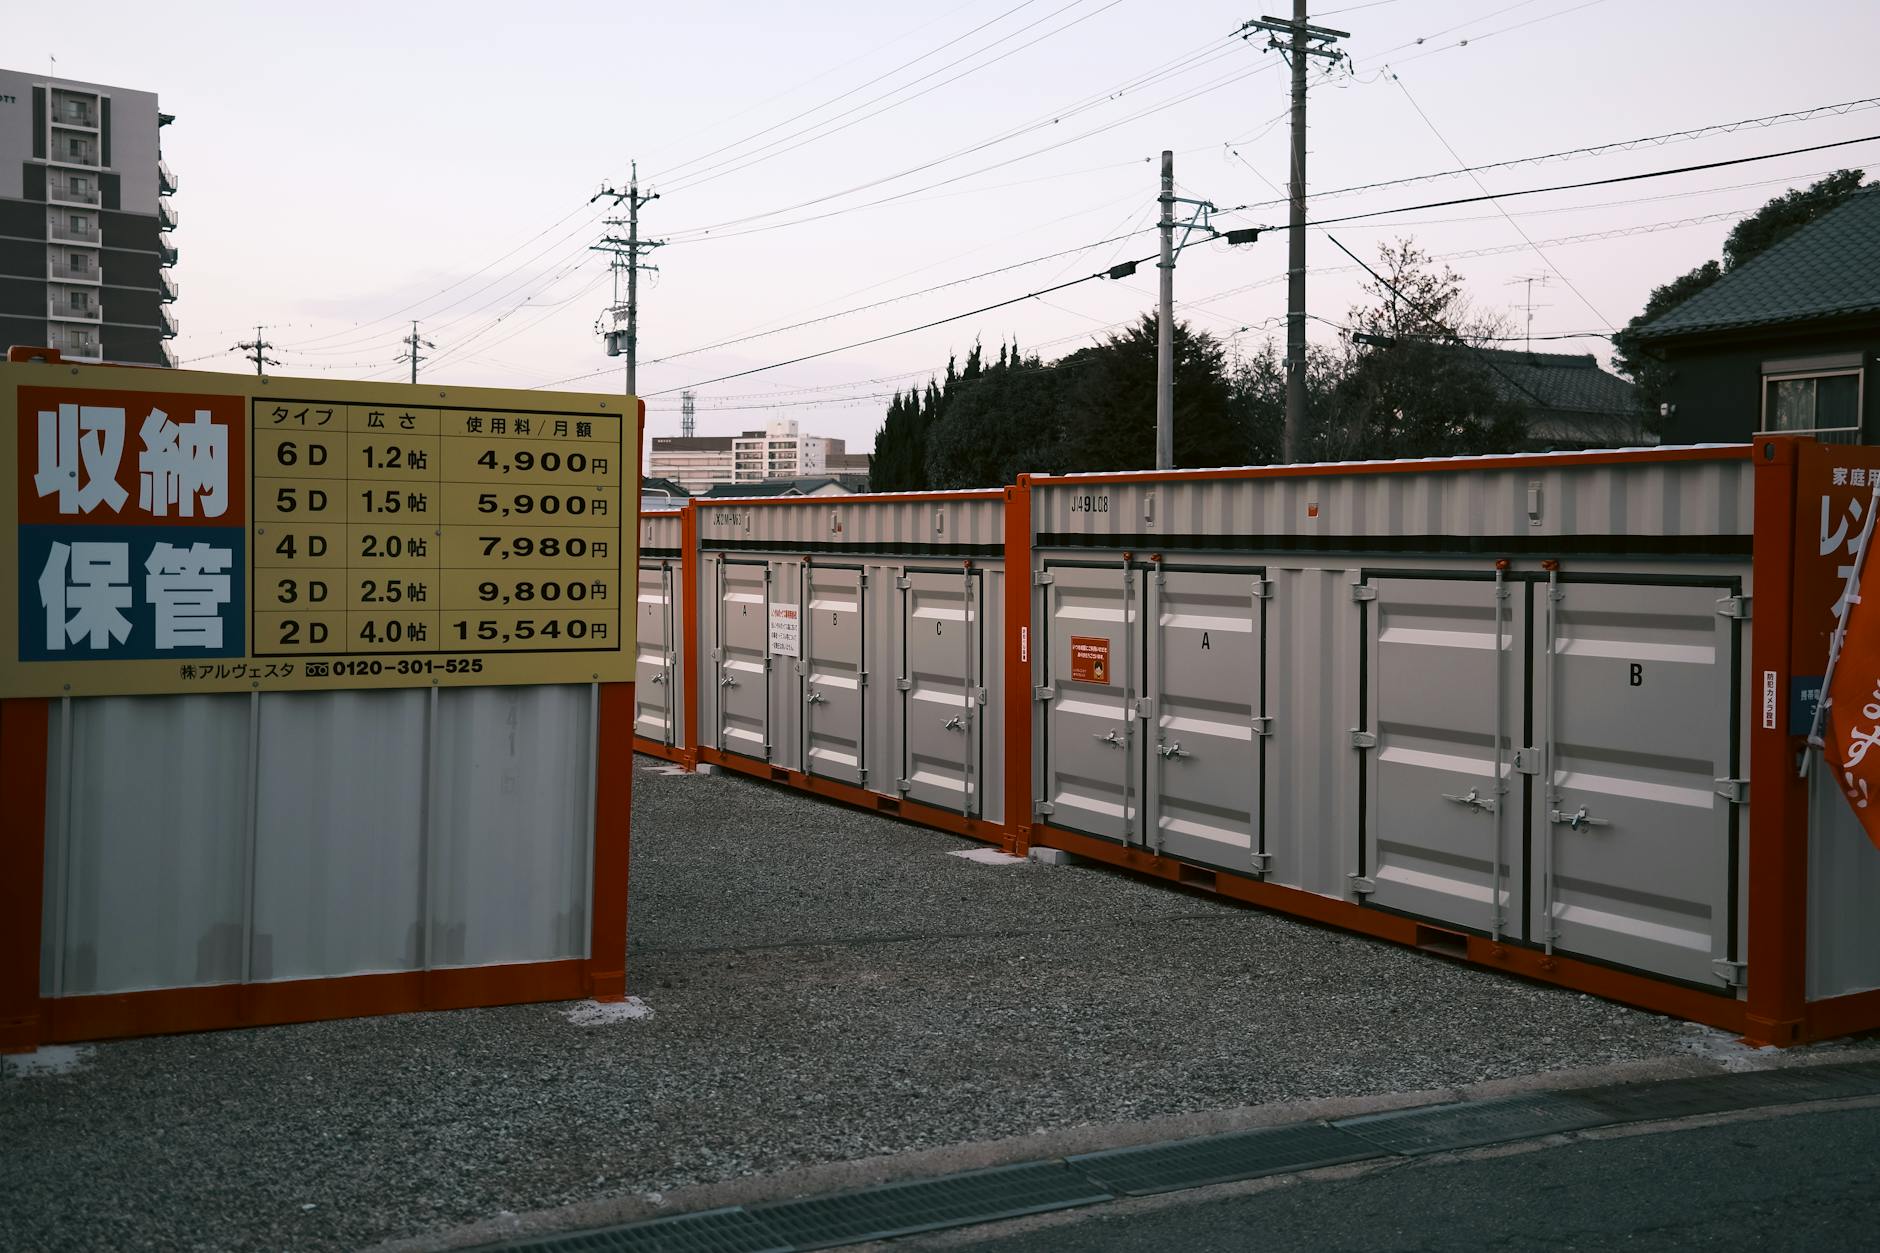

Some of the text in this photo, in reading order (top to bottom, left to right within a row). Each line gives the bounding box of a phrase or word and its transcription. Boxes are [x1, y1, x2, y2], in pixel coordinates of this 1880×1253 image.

[271, 406, 593, 438] タイプ 広さ 使用料/月額
[33, 403, 229, 517] 収納
[477, 450, 608, 475] 4,900円
[477, 493, 608, 517] 5,900円
[478, 537, 608, 559] 7,980円
[38, 540, 233, 650] 保管
[478, 581, 608, 602] 9,800円
[742, 604, 748, 617] A
[832, 612, 838, 626] B
[453, 619, 608, 643] 15,540円
[936, 621, 942, 636] C
[1201, 631, 1210, 650] A
[333, 658, 483, 676] 0120-301-525
[1630, 664, 1643, 686] B
